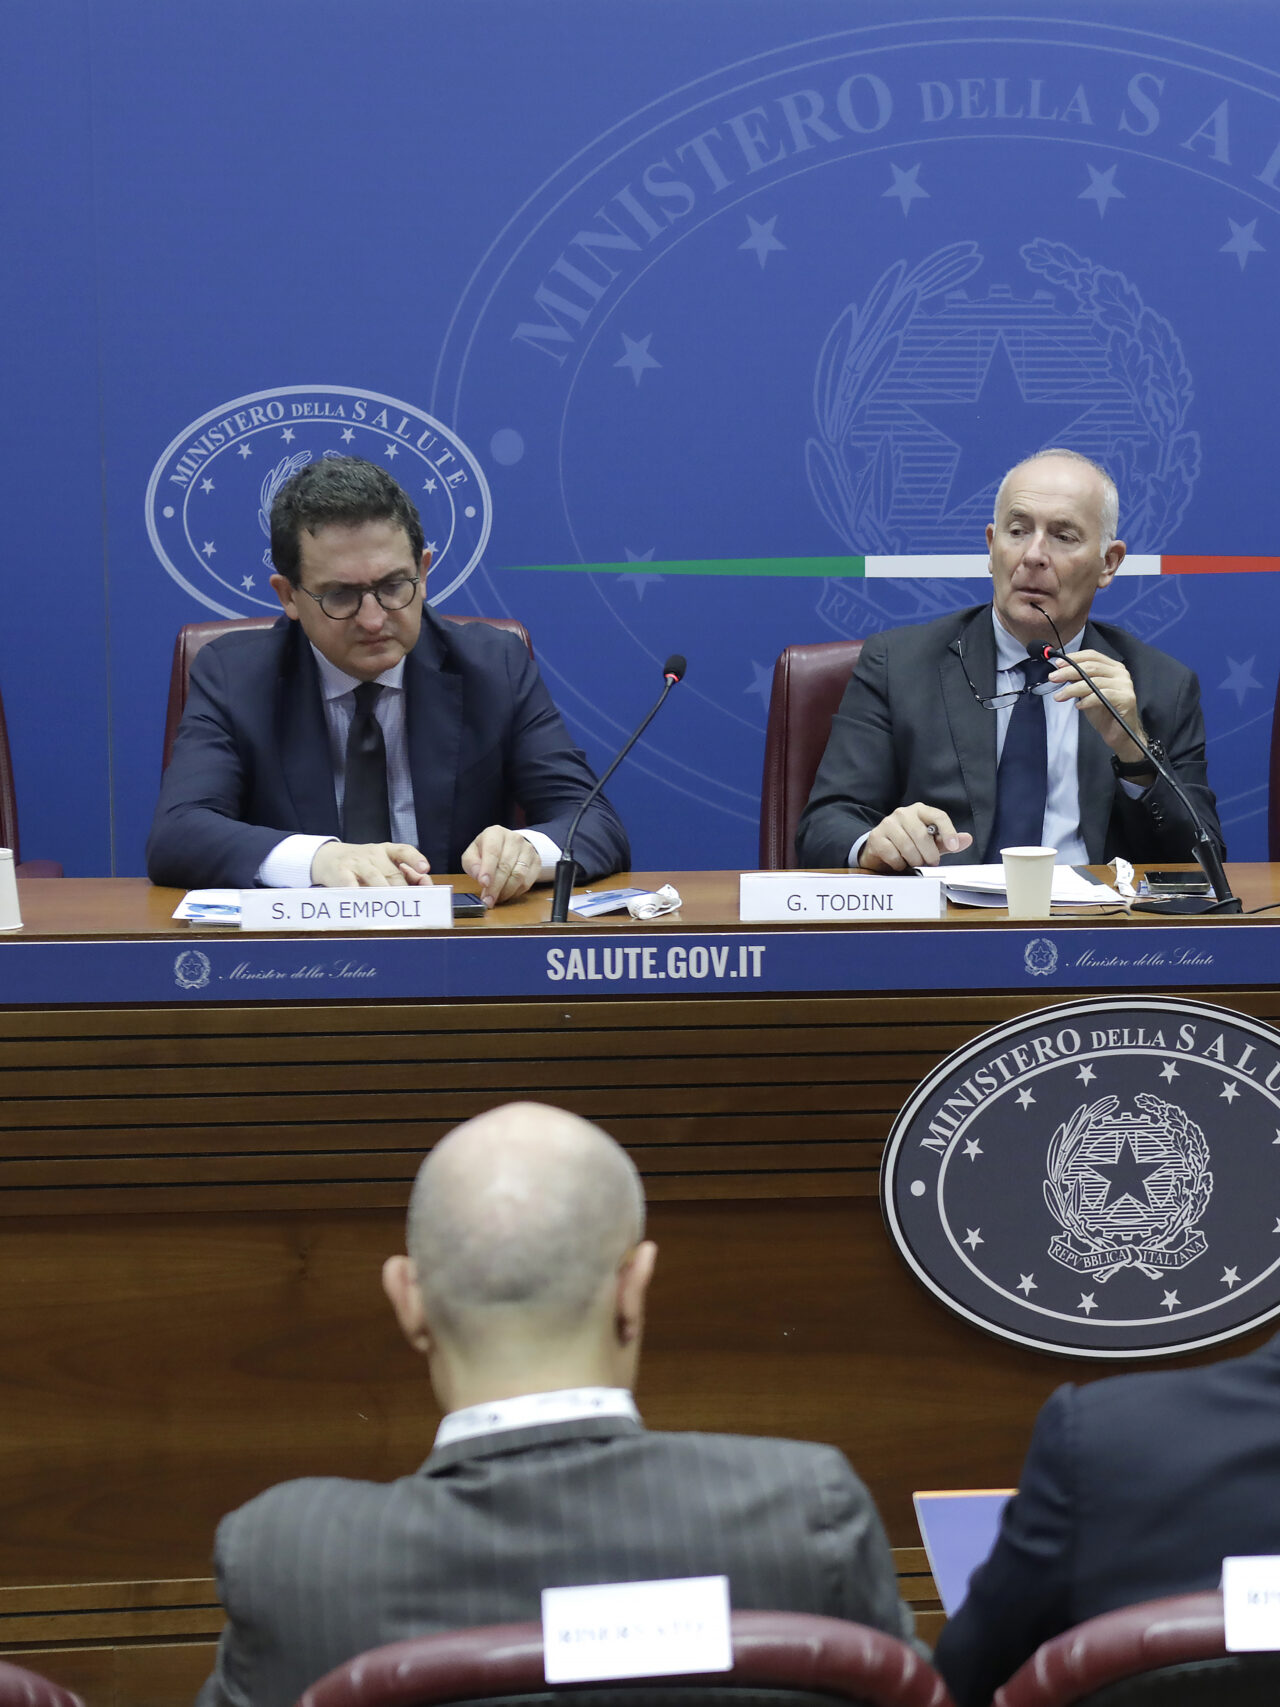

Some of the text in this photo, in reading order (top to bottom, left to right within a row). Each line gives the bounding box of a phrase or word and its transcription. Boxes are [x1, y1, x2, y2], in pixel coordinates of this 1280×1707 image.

[511, 73, 893, 367] MINISTERO
[917, 77, 1096, 126] DELLA
[169, 399, 469, 490] MINISTERO DELLA SALUTE
[271, 900, 422, 920] S. DA EMPOLI
[787, 894, 894, 911] G. TODINI
[218, 959, 378, 980] Ministero della Salute
[546, 945, 766, 980] SALUTE.GOV.IT
[1066, 947, 1215, 968] Ministero della Salute
[919, 1027, 1082, 1156] MINISTERO
[1090, 1027, 1167, 1050] DELLA
[1141, 1240, 1205, 1266] ITALIANA
